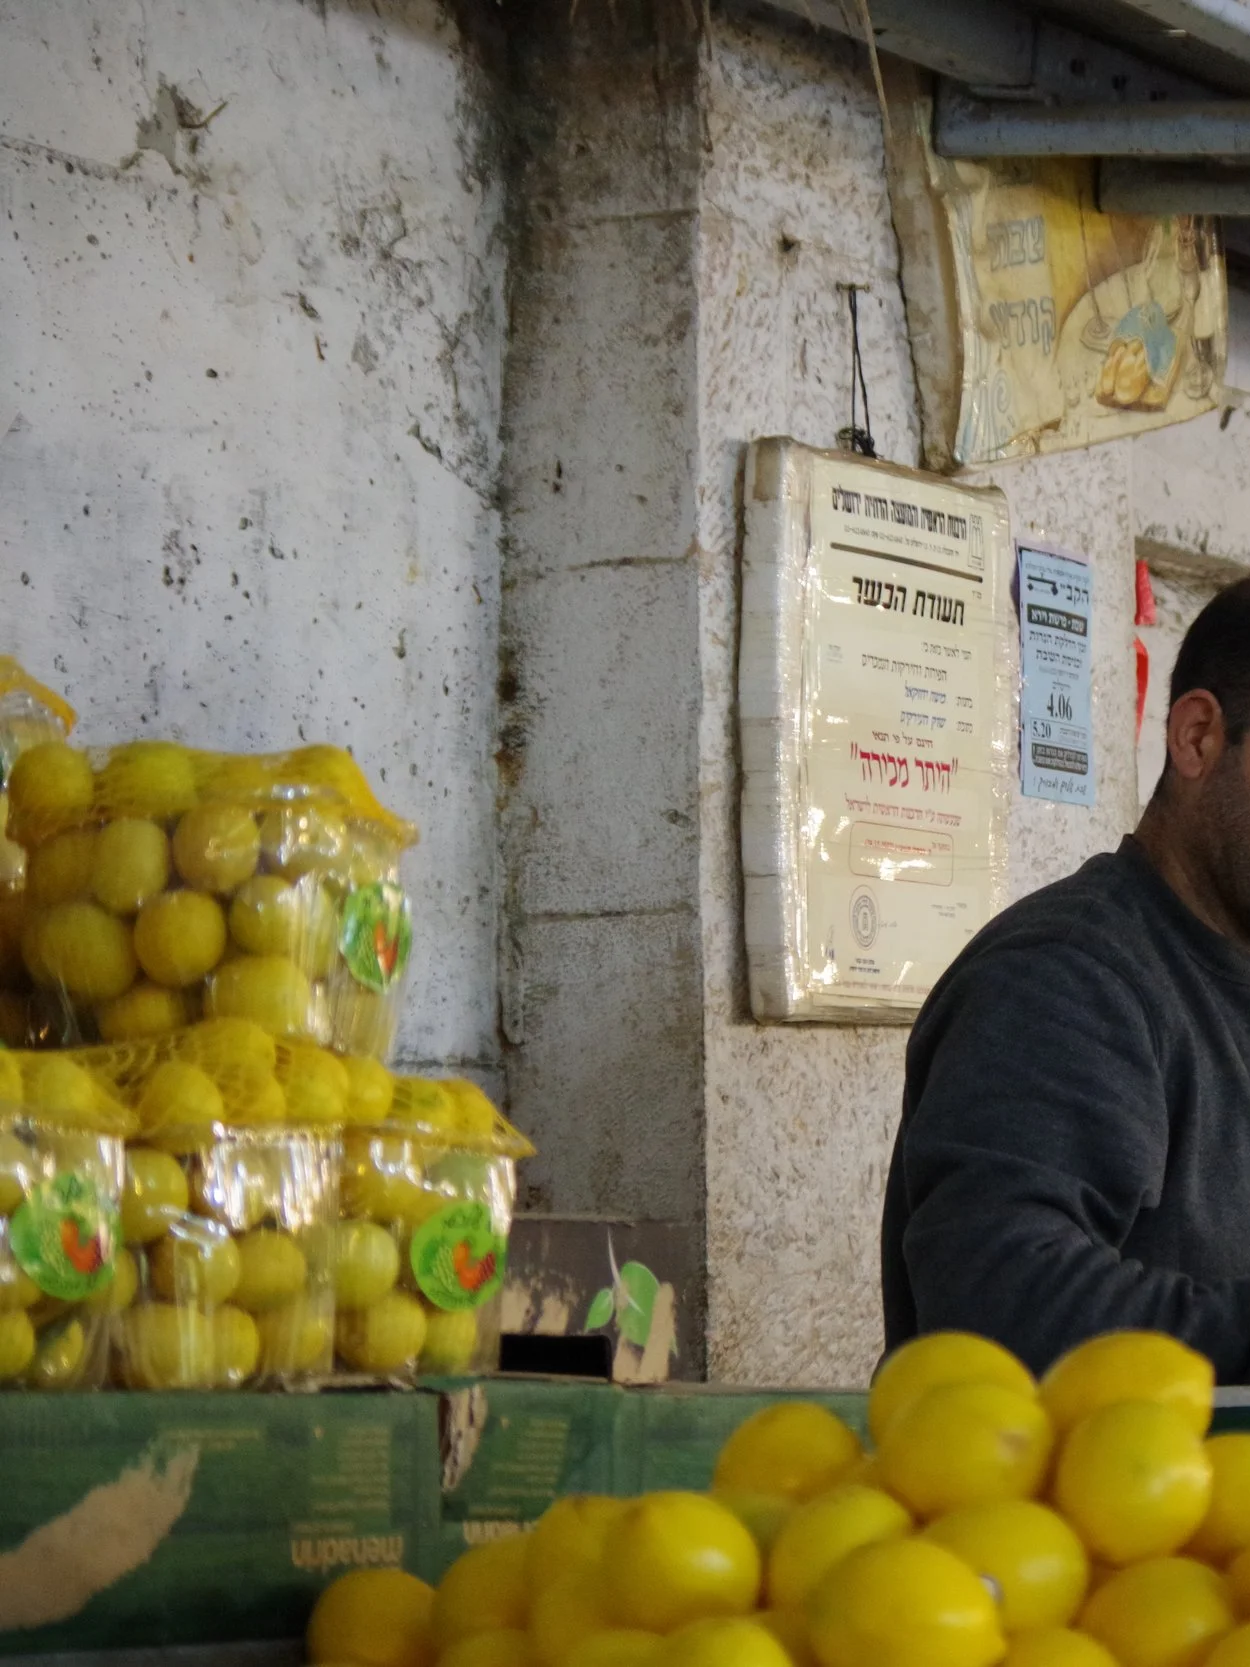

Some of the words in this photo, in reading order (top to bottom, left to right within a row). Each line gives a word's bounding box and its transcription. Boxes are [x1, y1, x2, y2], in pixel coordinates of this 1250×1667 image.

[987, 214, 1044, 272] שבת
[989, 296, 1056, 356] קודש
[920, 506, 945, 535] הראשית
[947, 514, 967, 540] הרבנות
[852, 576, 907, 613] הכשר
[912, 589, 965, 626] תעודת
[1047, 693, 1072, 721] 4.06
[1033, 721, 1051, 738] 5.20
